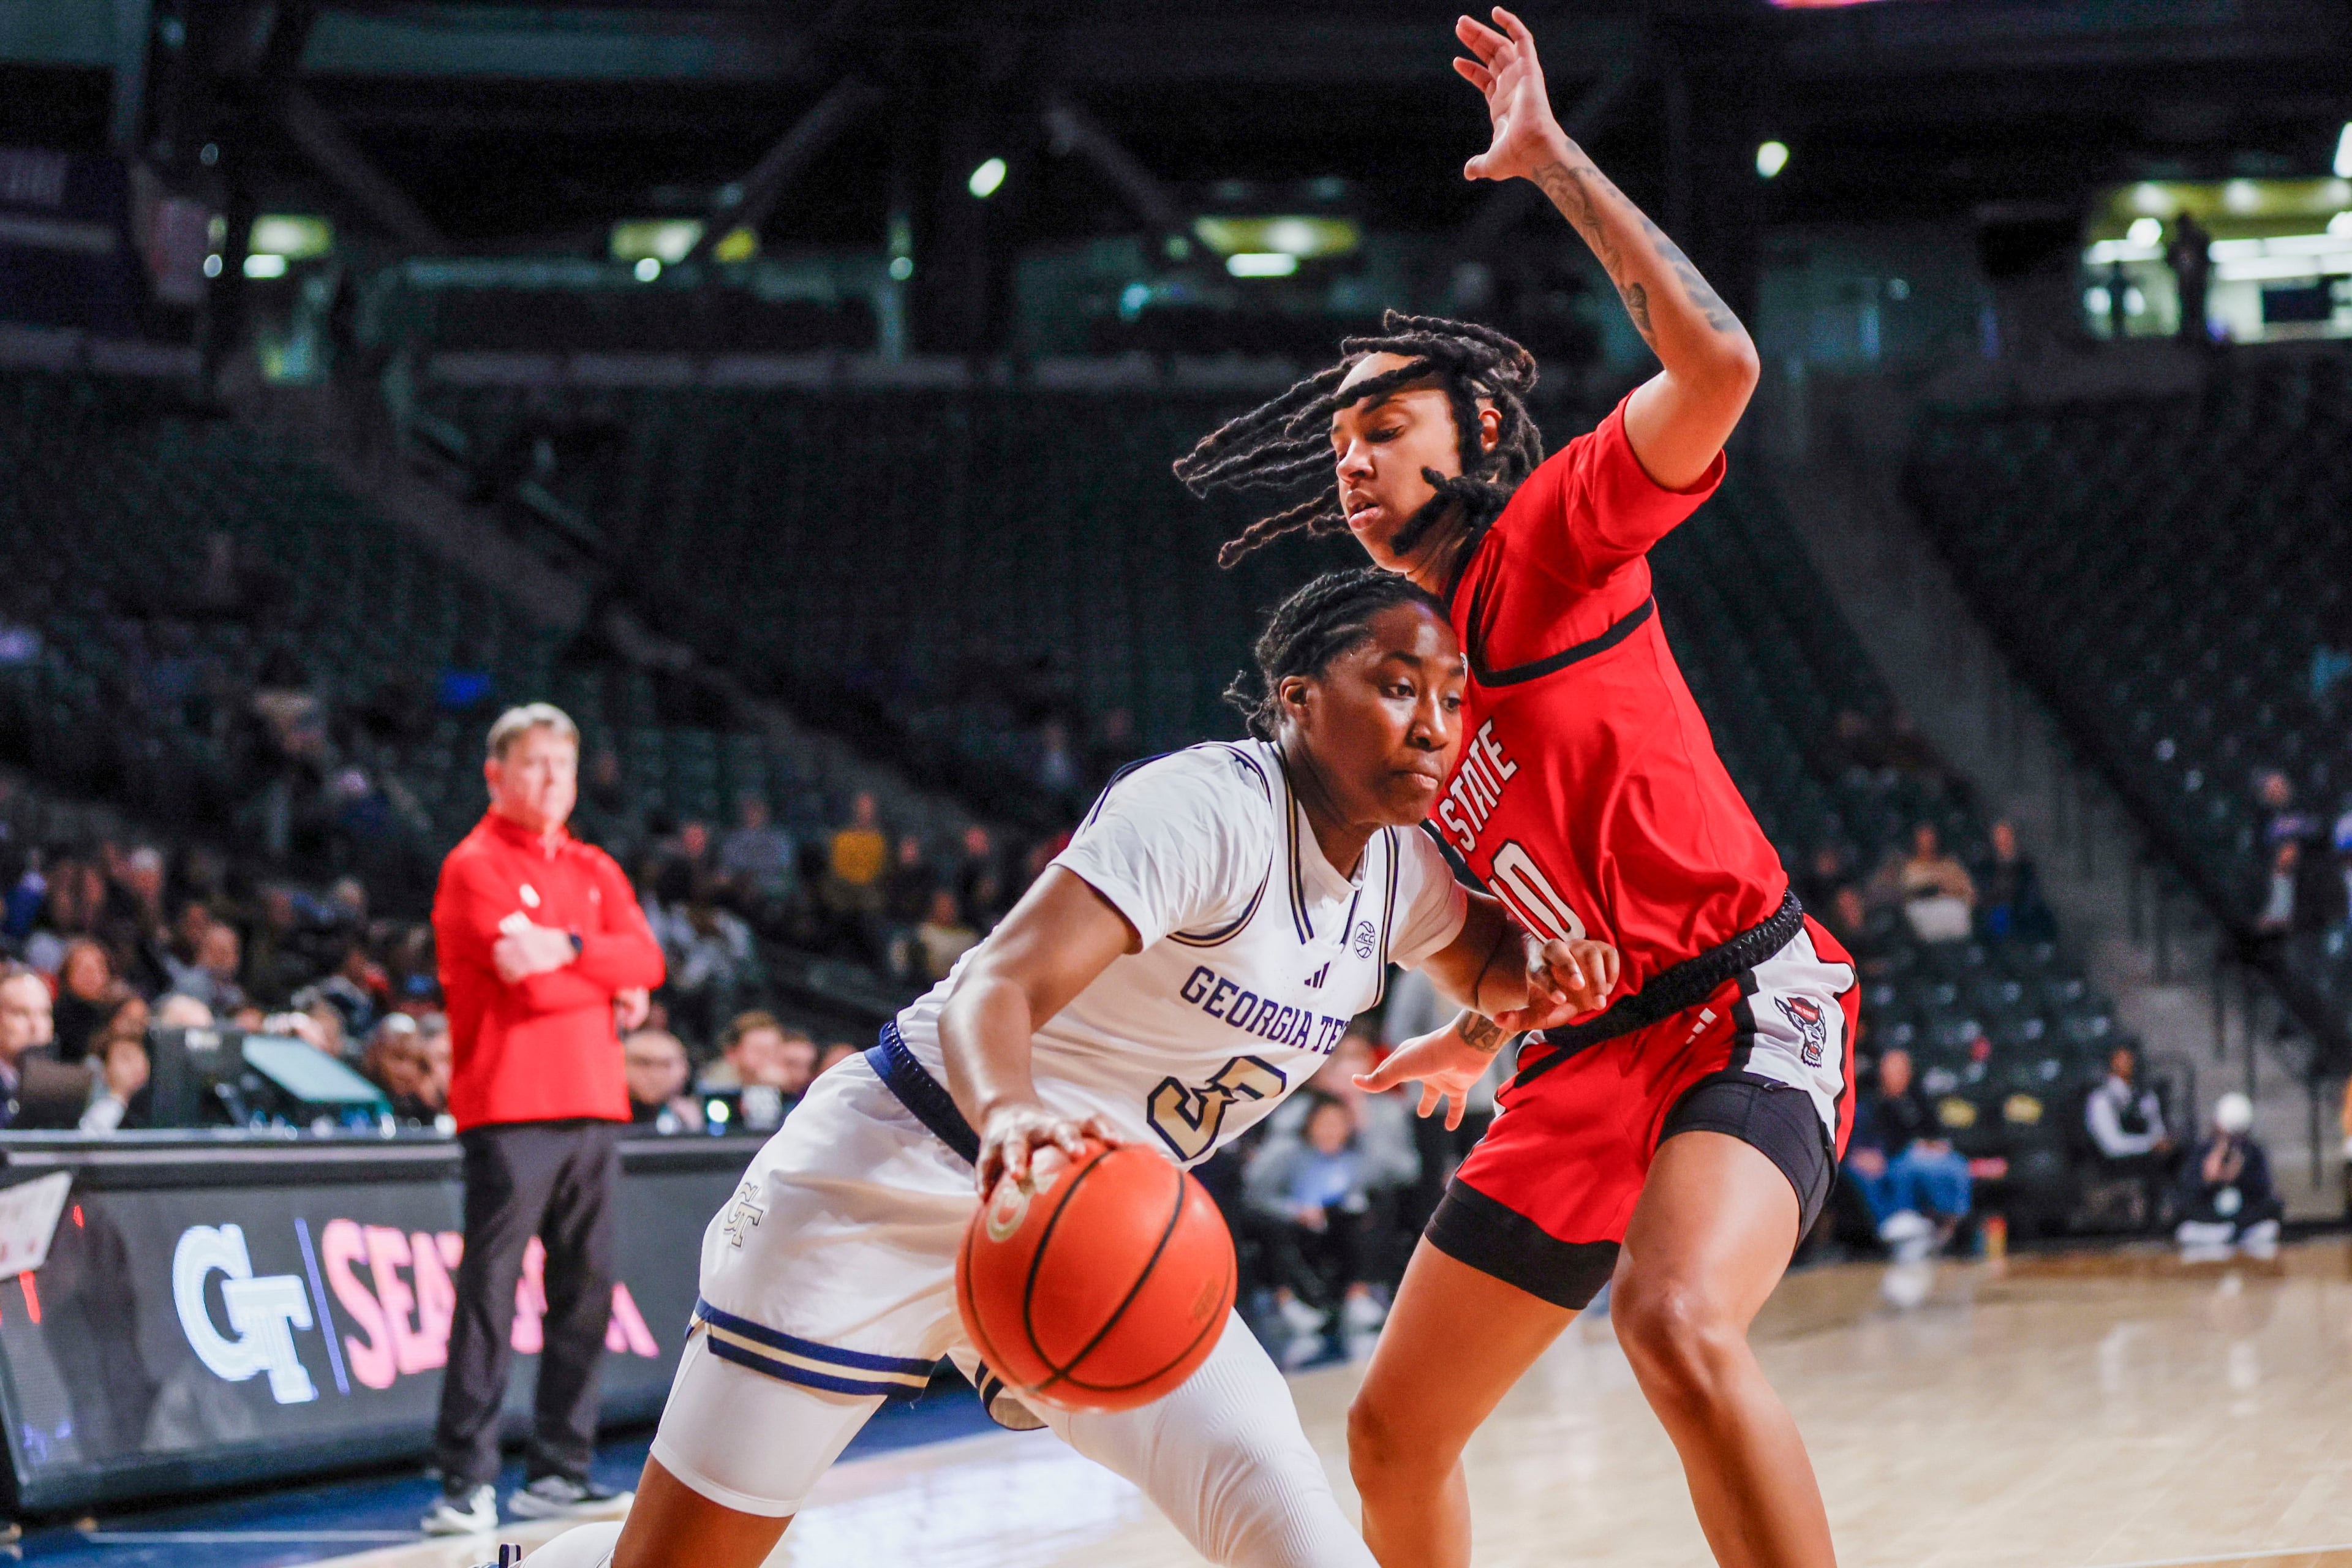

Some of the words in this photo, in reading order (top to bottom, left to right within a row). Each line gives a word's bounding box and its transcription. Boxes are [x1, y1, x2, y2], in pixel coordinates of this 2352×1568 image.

[1438, 716, 1519, 853] STATE
[1357, 932, 1374, 944] ACC
[1180, 965, 1313, 1049] GEORGIA
[1311, 1015, 1351, 1055] TE
[172, 1224, 317, 1404] GT
